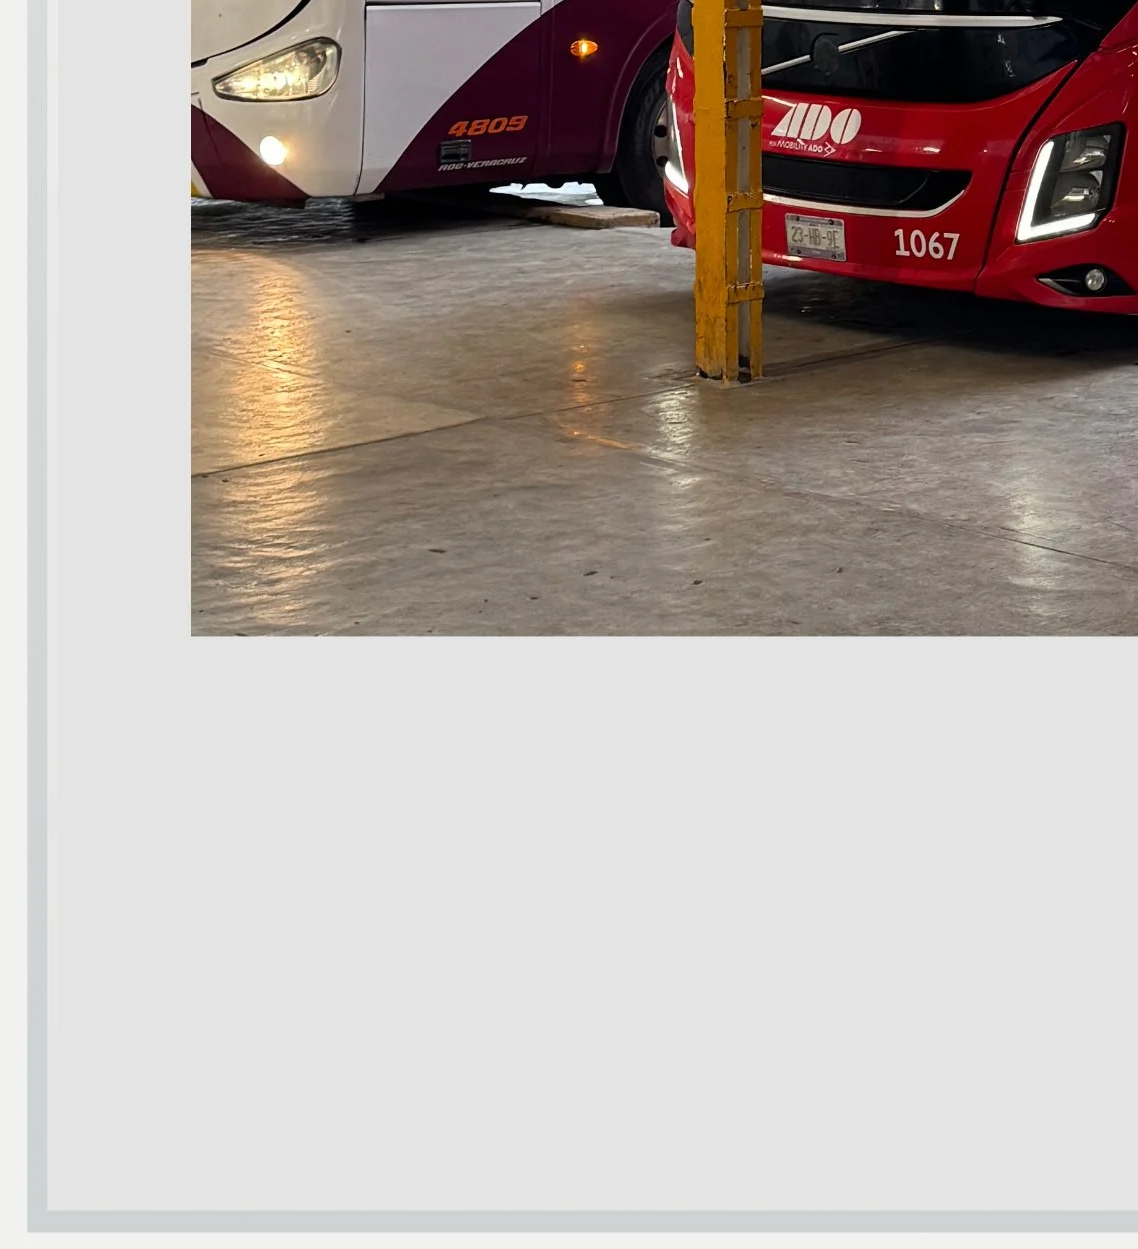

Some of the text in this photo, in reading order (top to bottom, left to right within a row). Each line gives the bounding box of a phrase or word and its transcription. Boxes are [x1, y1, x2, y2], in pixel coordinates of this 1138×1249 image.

[448, 115, 529, 137] 4809
[771, 102, 862, 145] ADO
[808, 143, 823, 153] ADO
[894, 228, 960, 261] 1067
